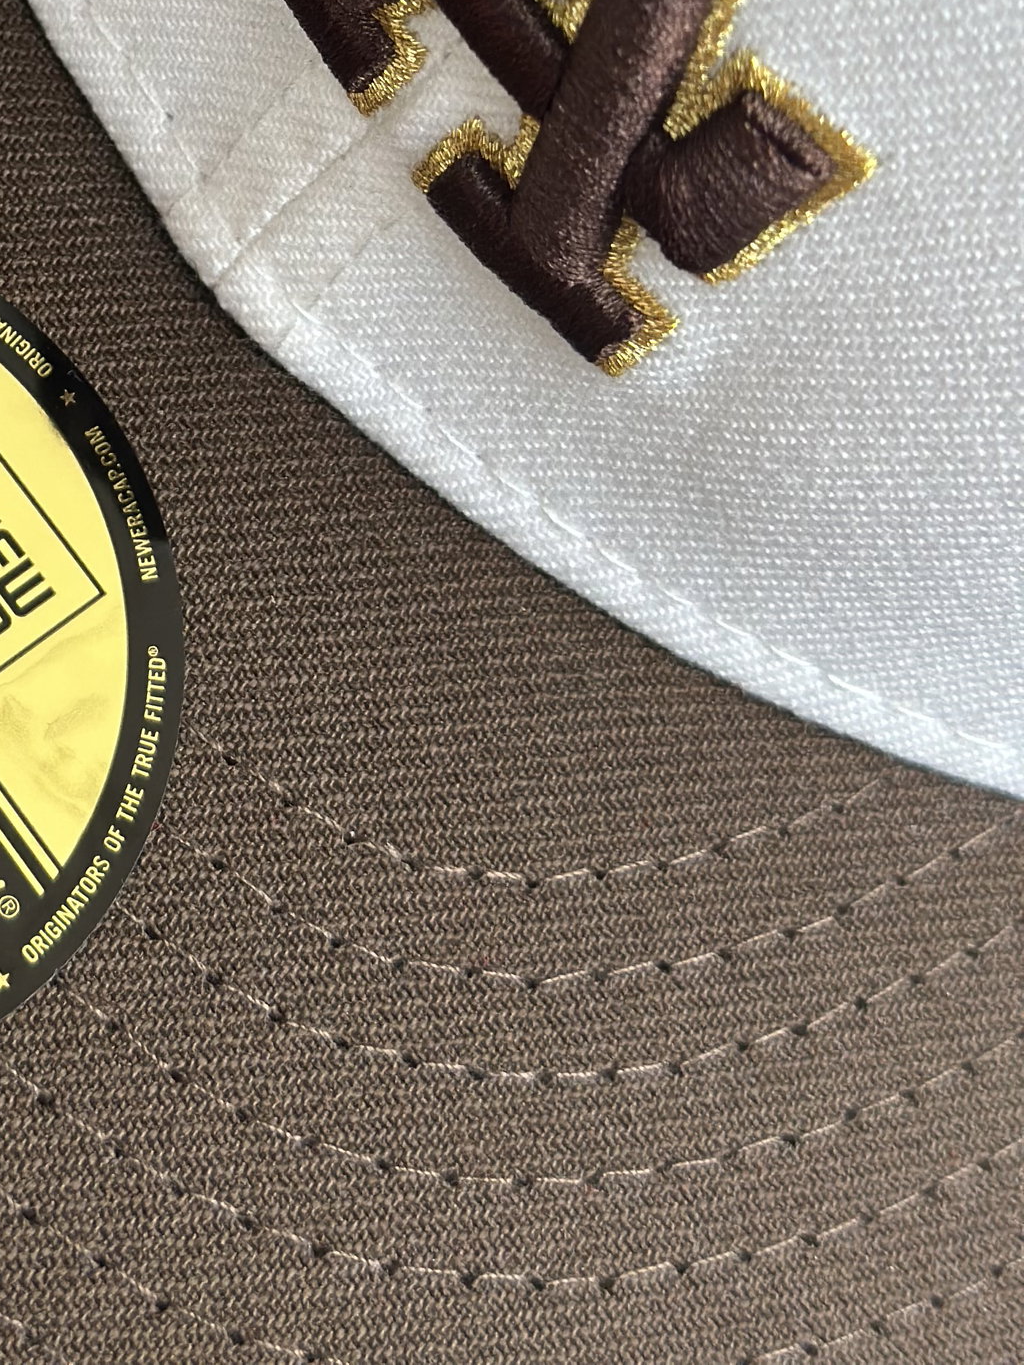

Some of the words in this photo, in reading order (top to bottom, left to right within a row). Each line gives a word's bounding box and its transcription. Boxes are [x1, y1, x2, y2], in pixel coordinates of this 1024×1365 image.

[85, 425, 158, 581] NEWERACAP.COM
[22, 855, 110, 964] ORIGINATORS
[104, 825, 126, 852] OF
[116, 784, 144, 823] THE
[132, 726, 159, 774] TRUE
